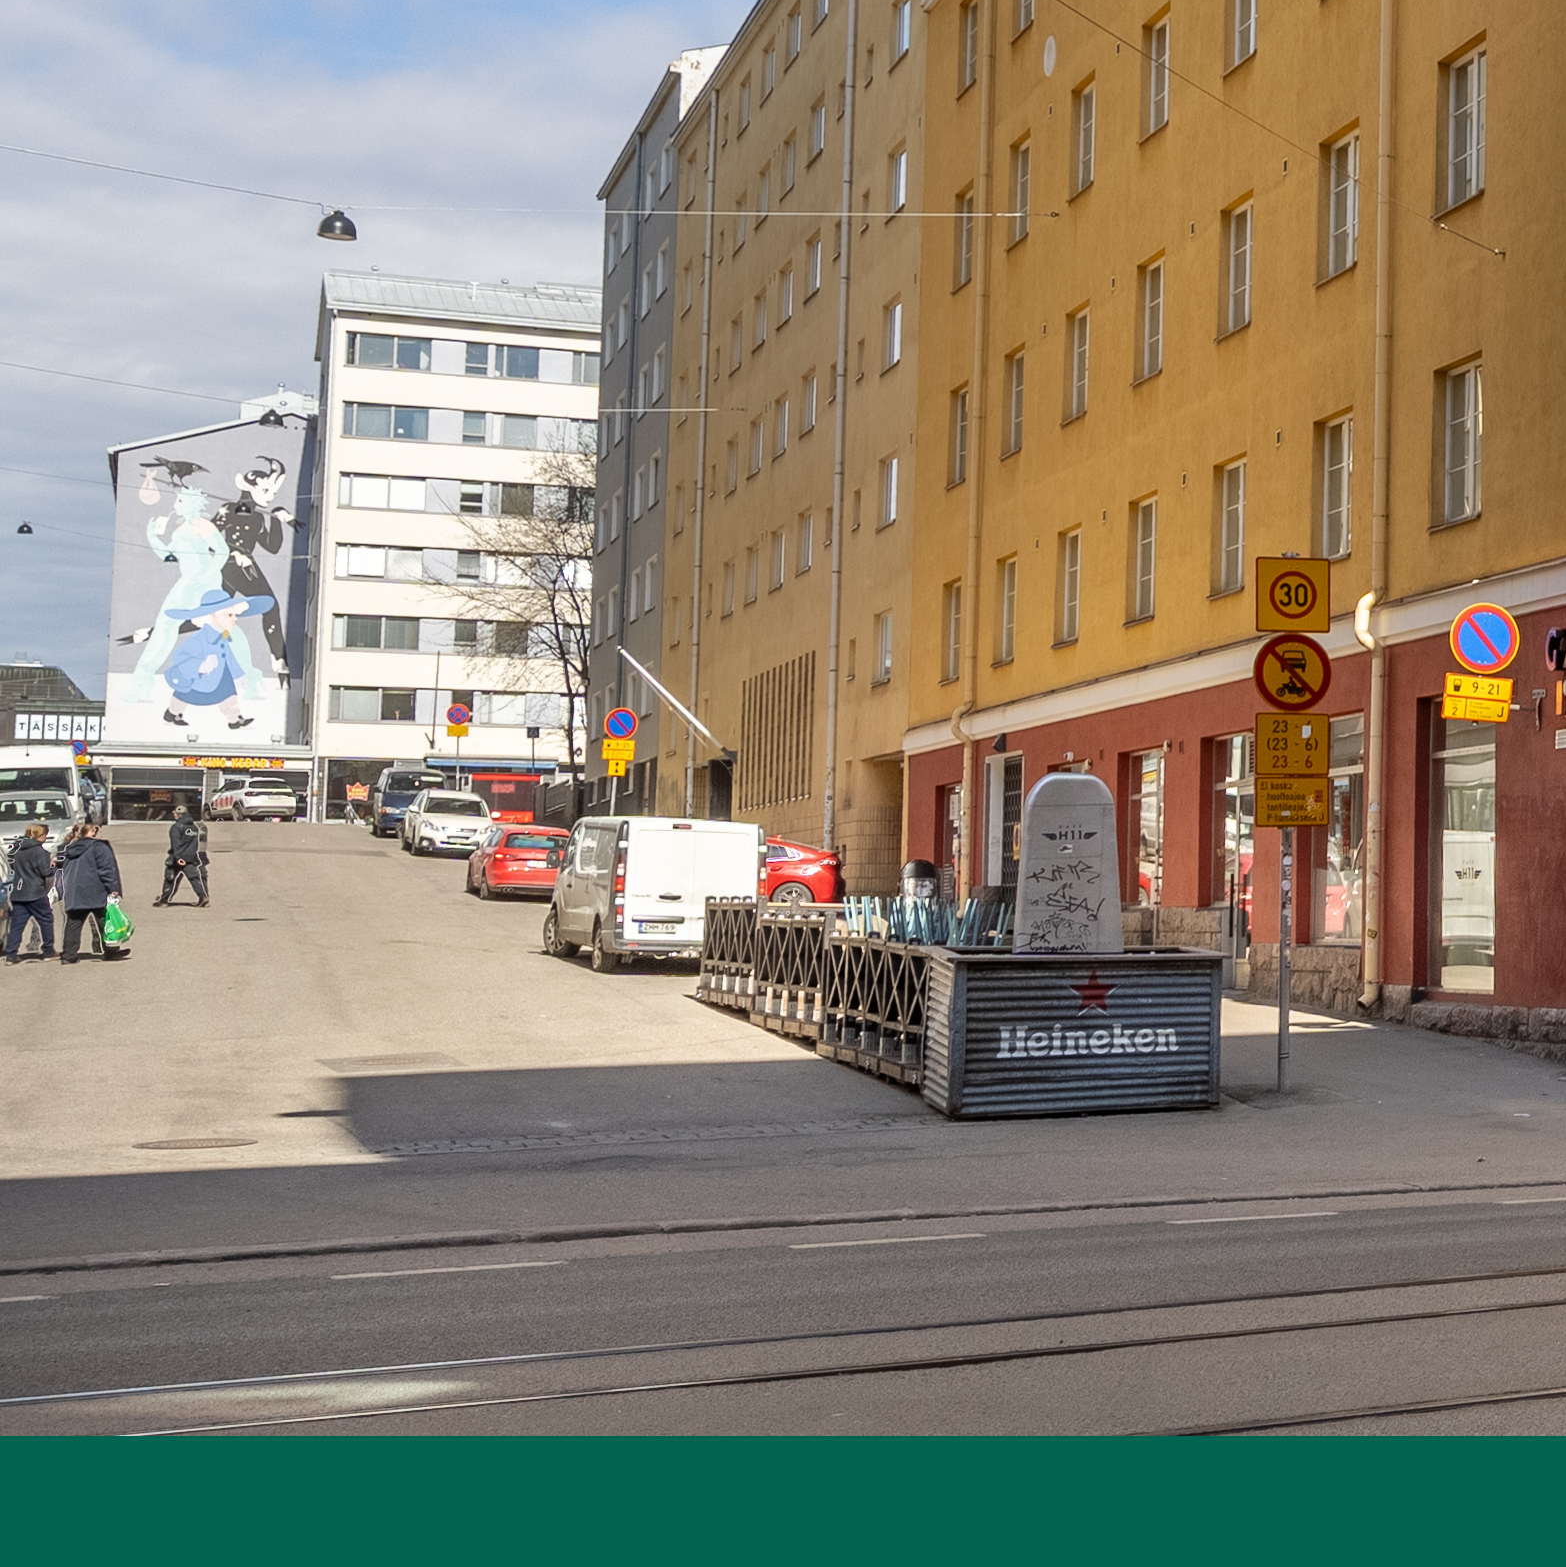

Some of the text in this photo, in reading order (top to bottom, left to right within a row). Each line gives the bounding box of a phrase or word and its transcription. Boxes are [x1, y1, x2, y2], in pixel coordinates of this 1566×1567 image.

[1279, 583, 1309, 607] 30
[1497, 707, 1504, 718] J
[1272, 720, 1288, 733] 23
[1267, 737, 1288, 751] (23
[1305, 738, 1318, 751] 6)
[1272, 755, 1288, 768] 23
[1305, 755, 1313, 769] 6
[1059, 830, 1082, 840] H11
[996, 1023, 1179, 1058] Heineken
